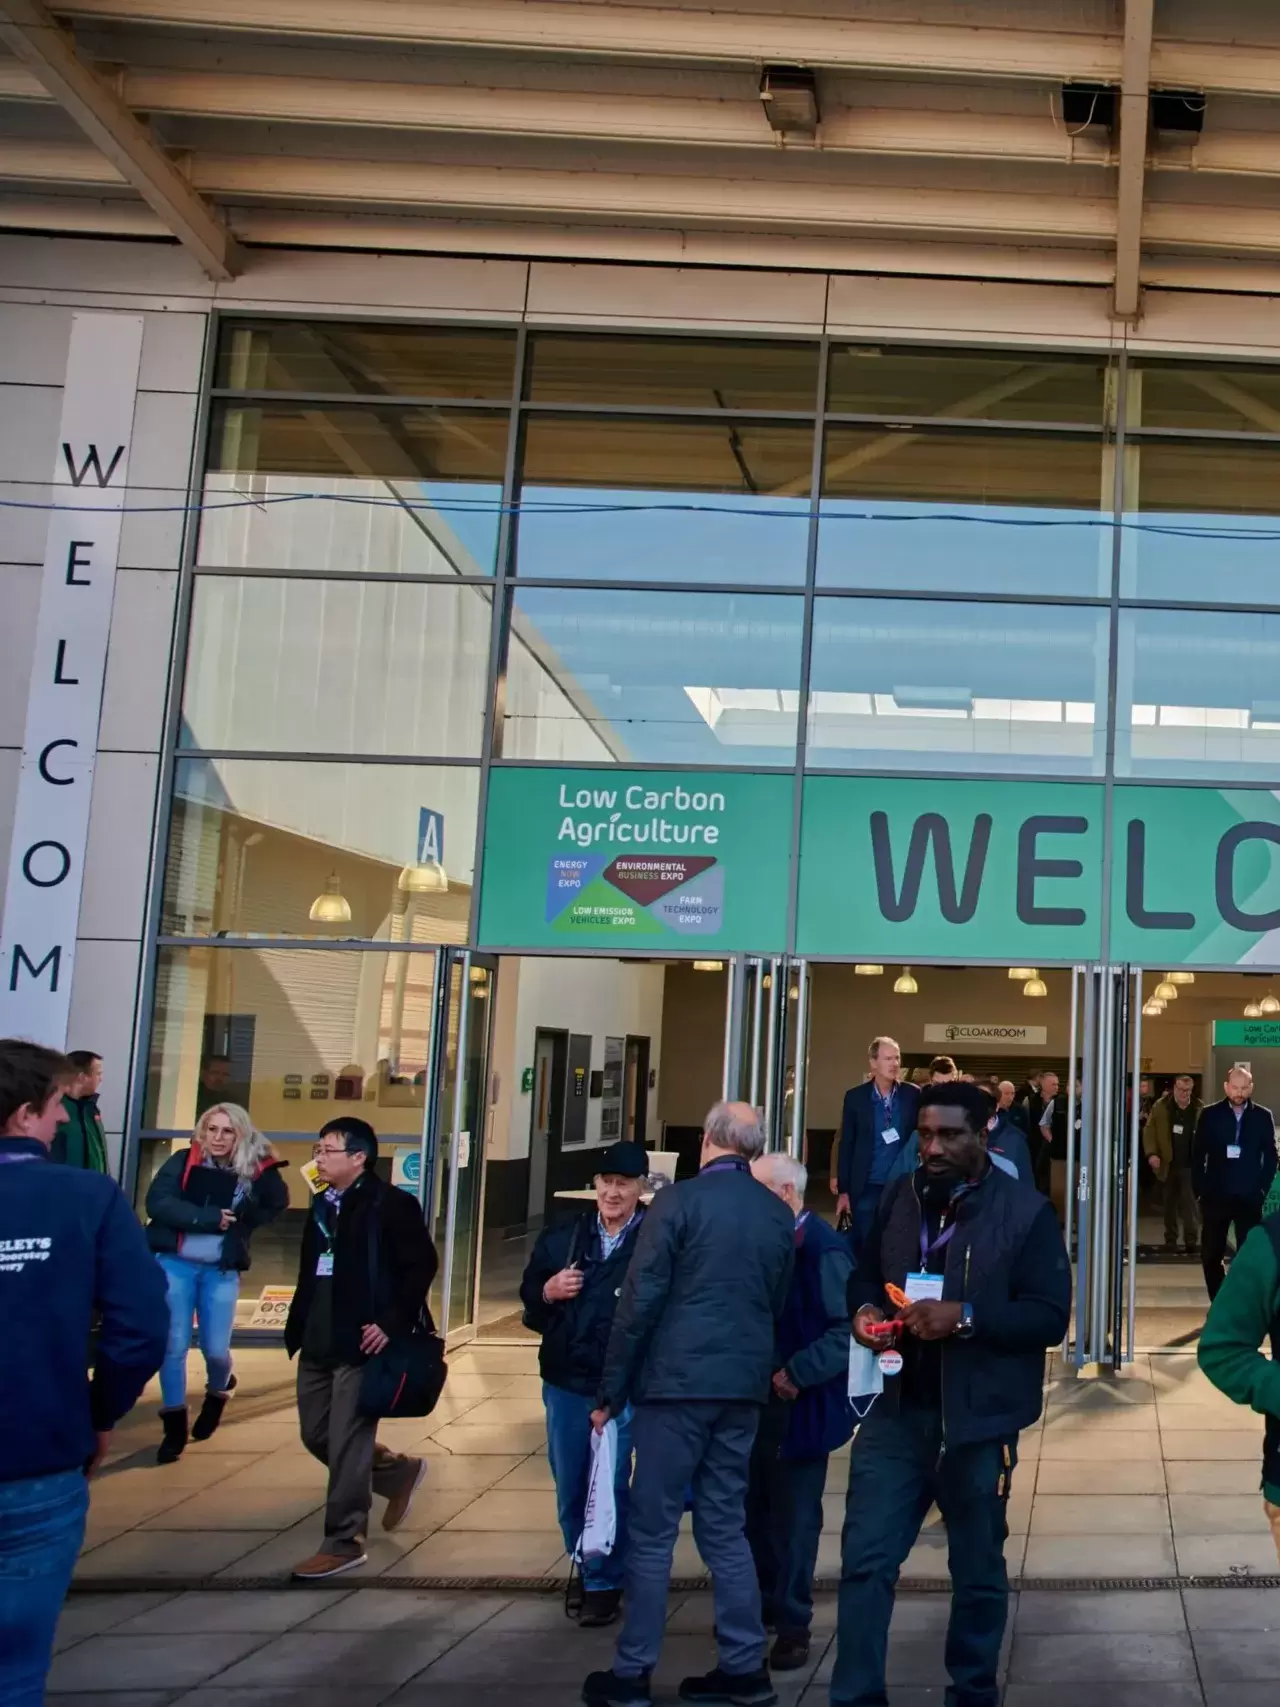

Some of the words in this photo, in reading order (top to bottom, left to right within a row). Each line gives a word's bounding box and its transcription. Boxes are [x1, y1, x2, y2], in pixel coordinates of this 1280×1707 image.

[559, 784, 617, 809] Low
[626, 786, 725, 811] Carbon
[558, 813, 720, 847] Agriculture
[554, 861, 588, 869] ENERGY
[616, 861, 687, 872] ENVIRONMENTAL
[618, 871, 659, 880] BUSINESS
[661, 872, 684, 881] EXPO
[558, 879, 581, 888] EXPO
[680, 896, 703, 904] FARM
[573, 906, 592, 915] LOW
[594, 907, 634, 916] EMISSION
[664, 905, 719, 915] TECHNOLOGY
[570, 916, 610, 925] VEHICLES
[613, 916, 636, 925] EXPO
[679, 915, 702, 924] EXPO
[960, 1027, 1026, 1038] CLOAKROOM
[1244, 1024, 1262, 1033] Low
